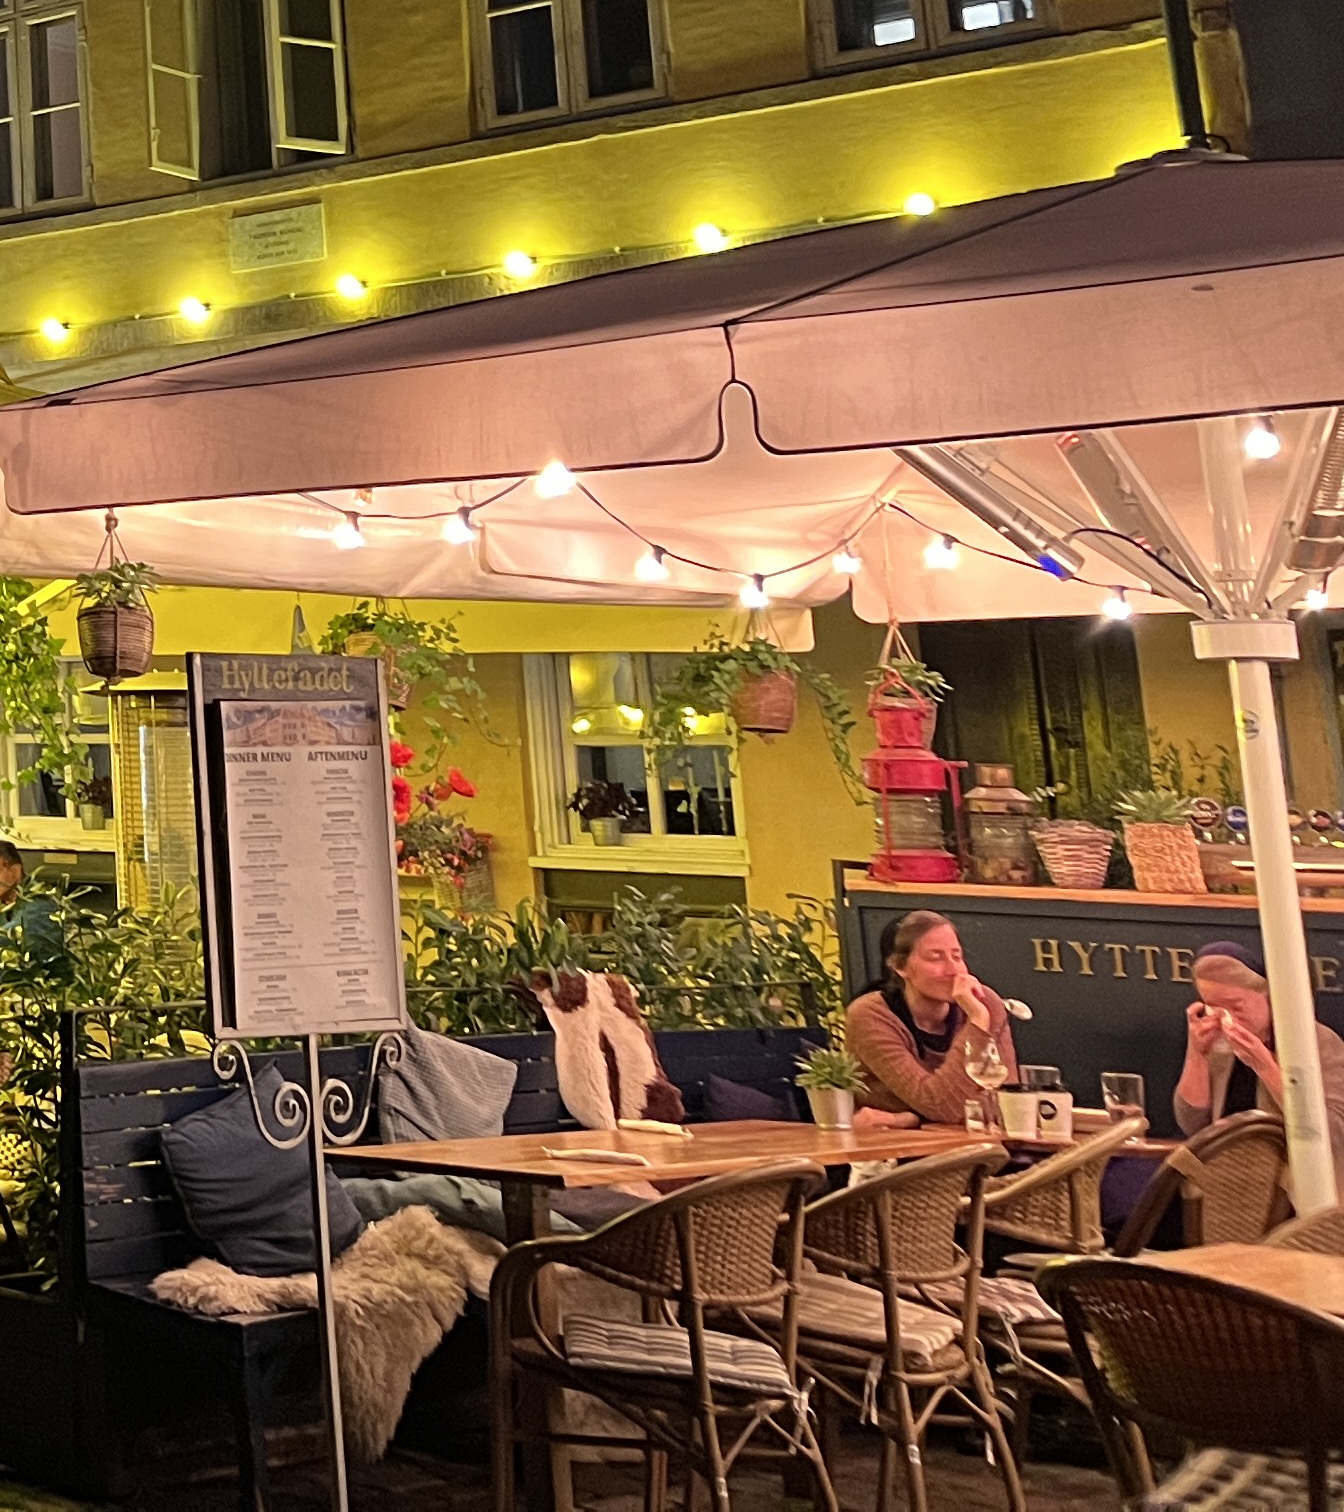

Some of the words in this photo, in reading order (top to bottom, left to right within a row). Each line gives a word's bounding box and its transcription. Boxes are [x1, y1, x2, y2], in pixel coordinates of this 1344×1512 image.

[221, 659, 354, 698] Hyttefadet
[260, 751, 292, 763] MENU
[307, 750, 368, 762] AFTENMENU
